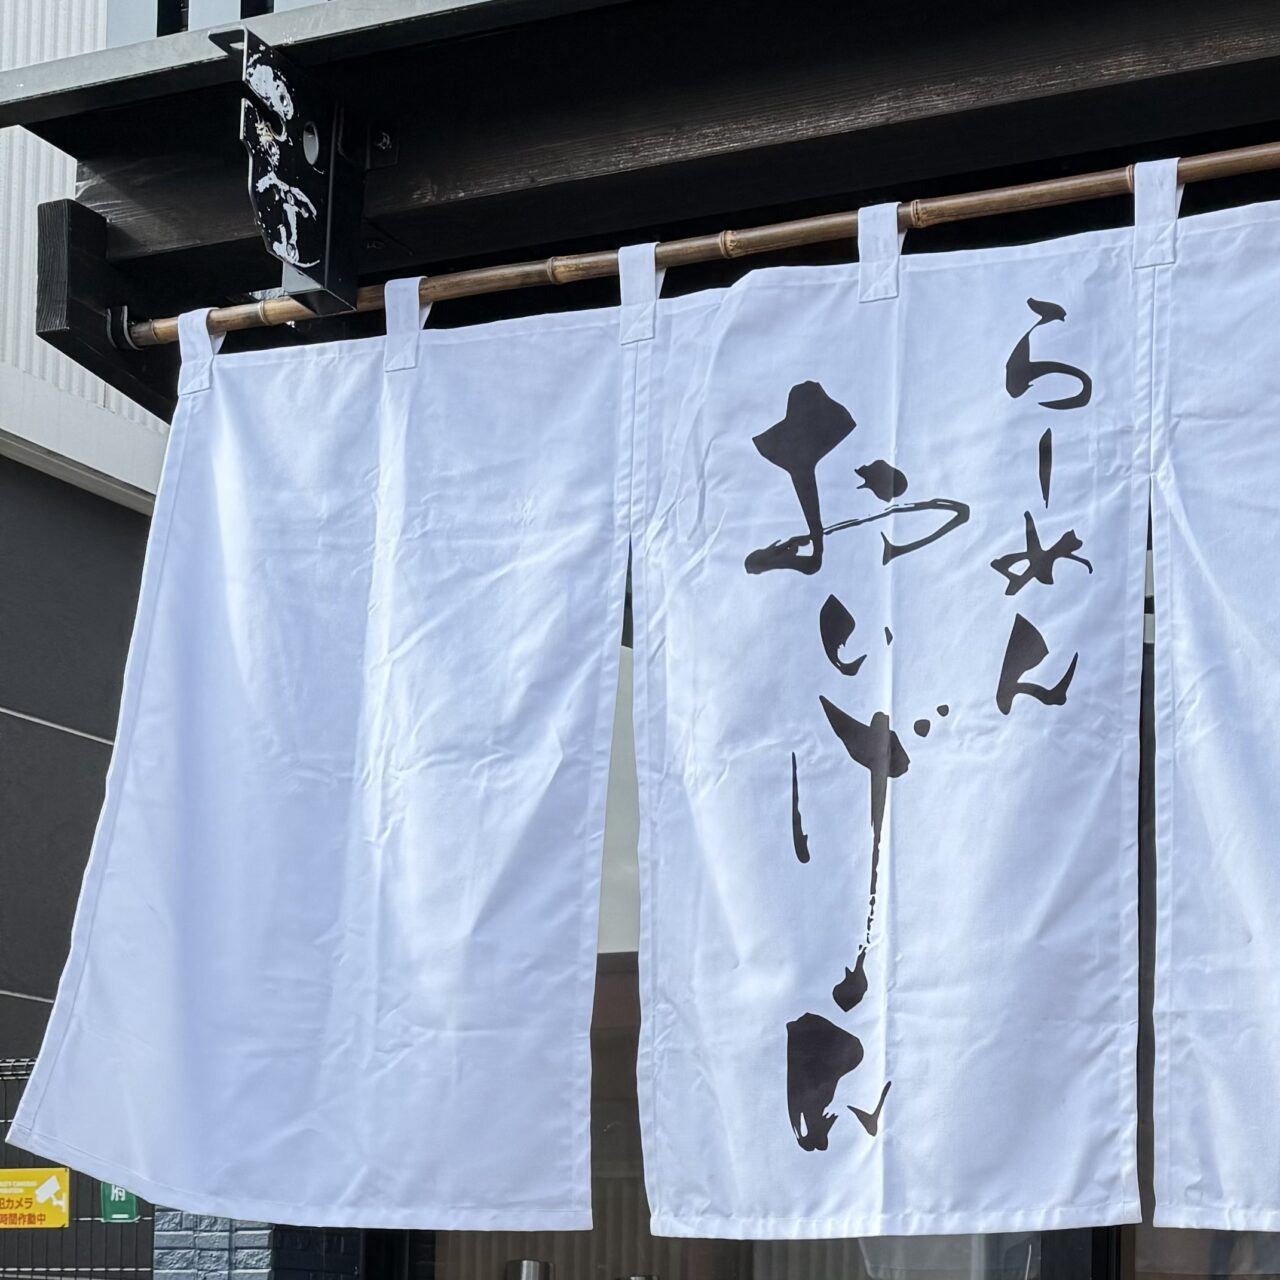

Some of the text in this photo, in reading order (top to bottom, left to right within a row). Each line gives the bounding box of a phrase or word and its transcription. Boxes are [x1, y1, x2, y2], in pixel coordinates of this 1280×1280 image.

[744, 380, 970, 1152] おいげん
[990, 297, 1093, 716] らーめん
